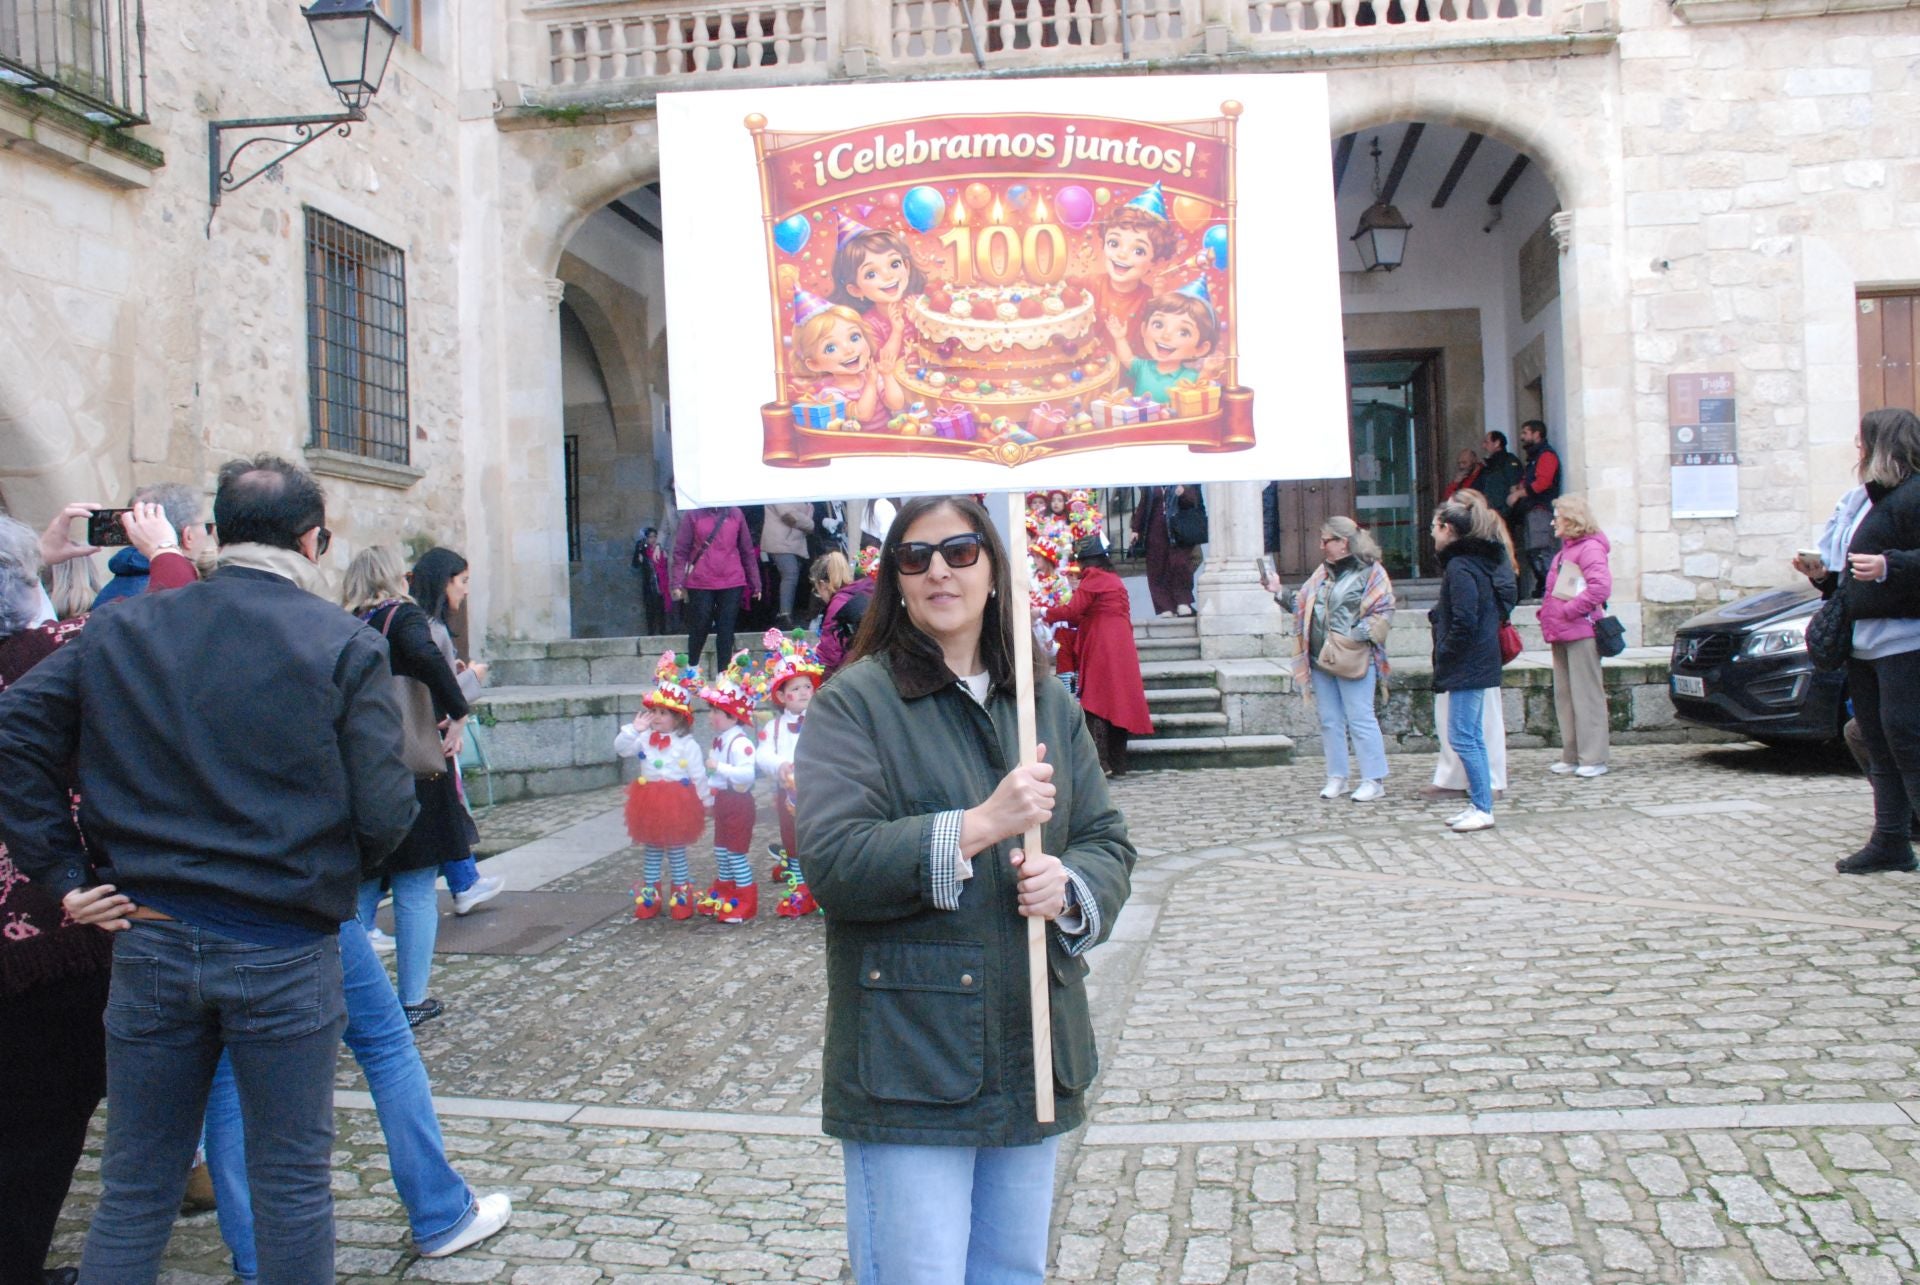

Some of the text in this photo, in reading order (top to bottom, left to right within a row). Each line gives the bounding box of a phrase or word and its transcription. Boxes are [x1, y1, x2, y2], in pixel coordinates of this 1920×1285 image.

[813, 125, 1197, 187] ¡Celebramos juntos!
[939, 223, 1069, 287] 100
